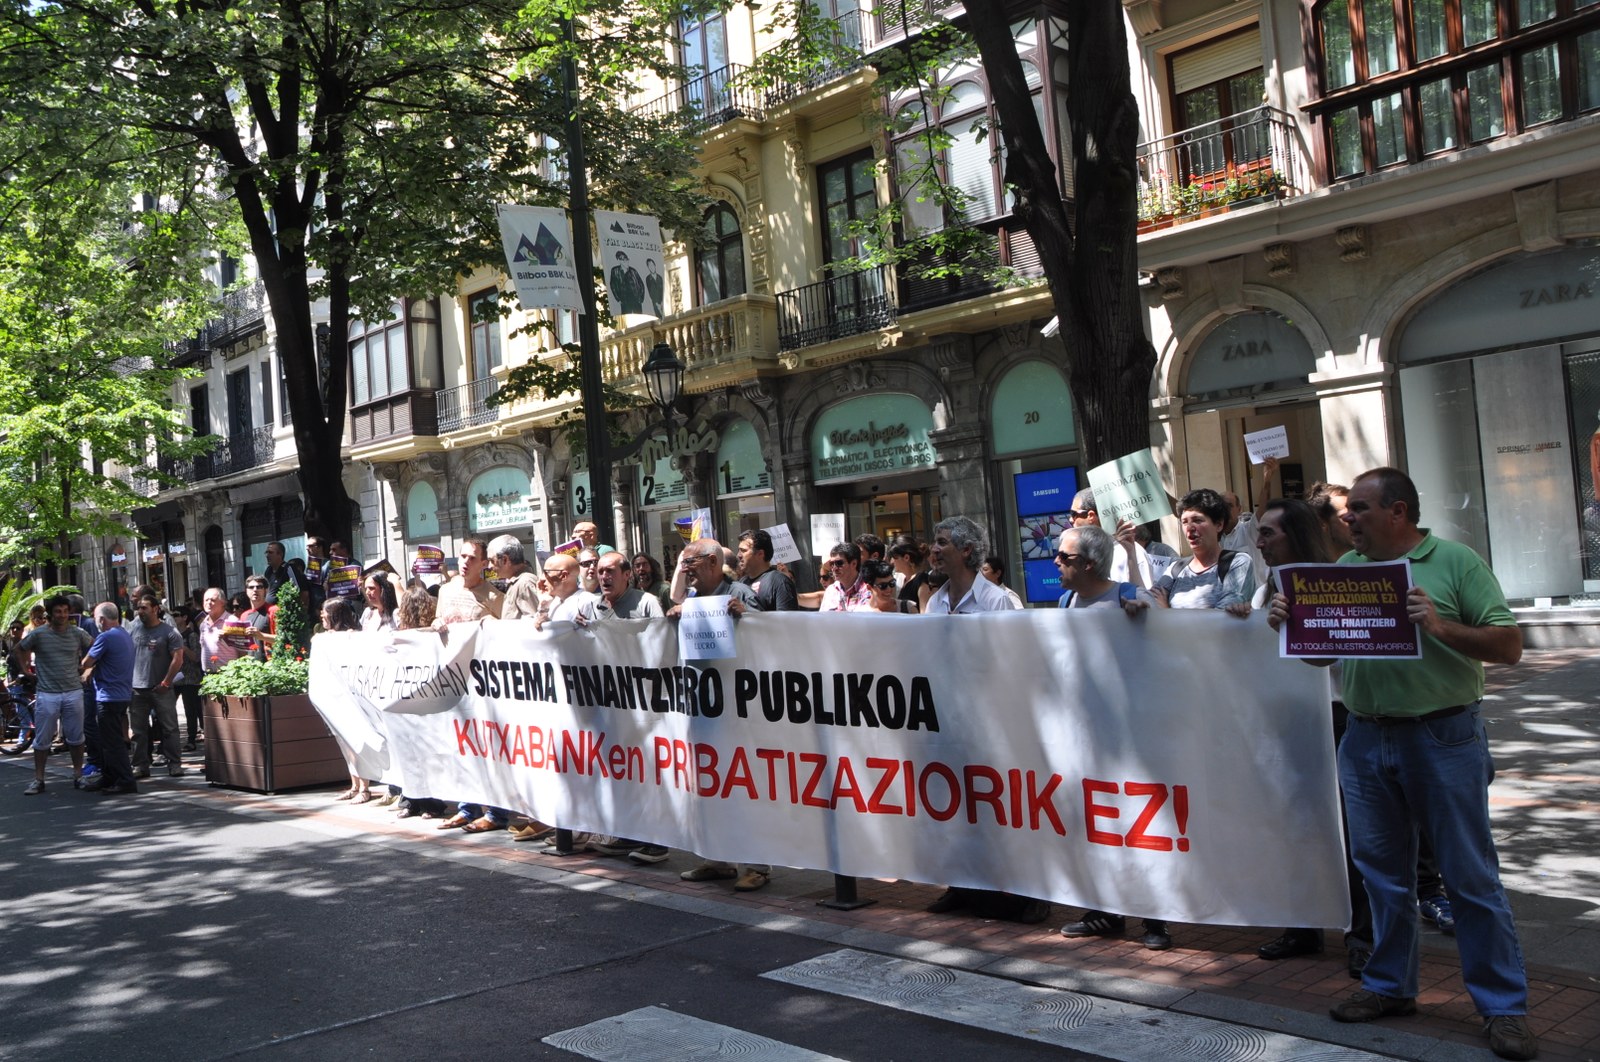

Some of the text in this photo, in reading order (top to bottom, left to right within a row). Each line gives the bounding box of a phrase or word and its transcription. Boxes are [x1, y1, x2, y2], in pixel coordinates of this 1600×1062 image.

[517, 271, 547, 280] Bilbao
[548, 270, 564, 279] BBK
[1519, 283, 1592, 309] ZARA
[1222, 339, 1275, 361] ZARA
[1024, 410, 1040, 424] 20
[865, 458, 895, 471] DISCOS
[901, 453, 932, 466] LIBROS
[720, 460, 732, 494] 1
[643, 475, 656, 505] 2
[1033, 488, 1060, 496] SAMSUNG
[575, 486, 587, 514] 3
[1140, 494, 1154, 505] DE
[1295, 593, 1398, 605] PRIBATIZAZIORIK EZ!
[1316, 606, 1382, 617] EUSKAL HERRIAN
[1303, 618, 1396, 628] SISTEMA FINANTZIERO
[717, 630, 728, 638] DE
[1329, 629, 1370, 639] PUBLIKOA
[694, 642, 716, 650] LUCRO
[1290, 642, 1303, 651] NO
[1335, 642, 1375, 651] NUESTROS
[1376, 642, 1414, 651] AHORROS
[391, 662, 469, 699] HERRIAN
[470, 659, 557, 704] SISTEMA
[561, 664, 724, 719] FINANTZIERO
[735, 669, 939, 733] PUBLIKOA
[453, 718, 1190, 853] KUTXABANKen PRIBATIZAZIORIK EZ!
